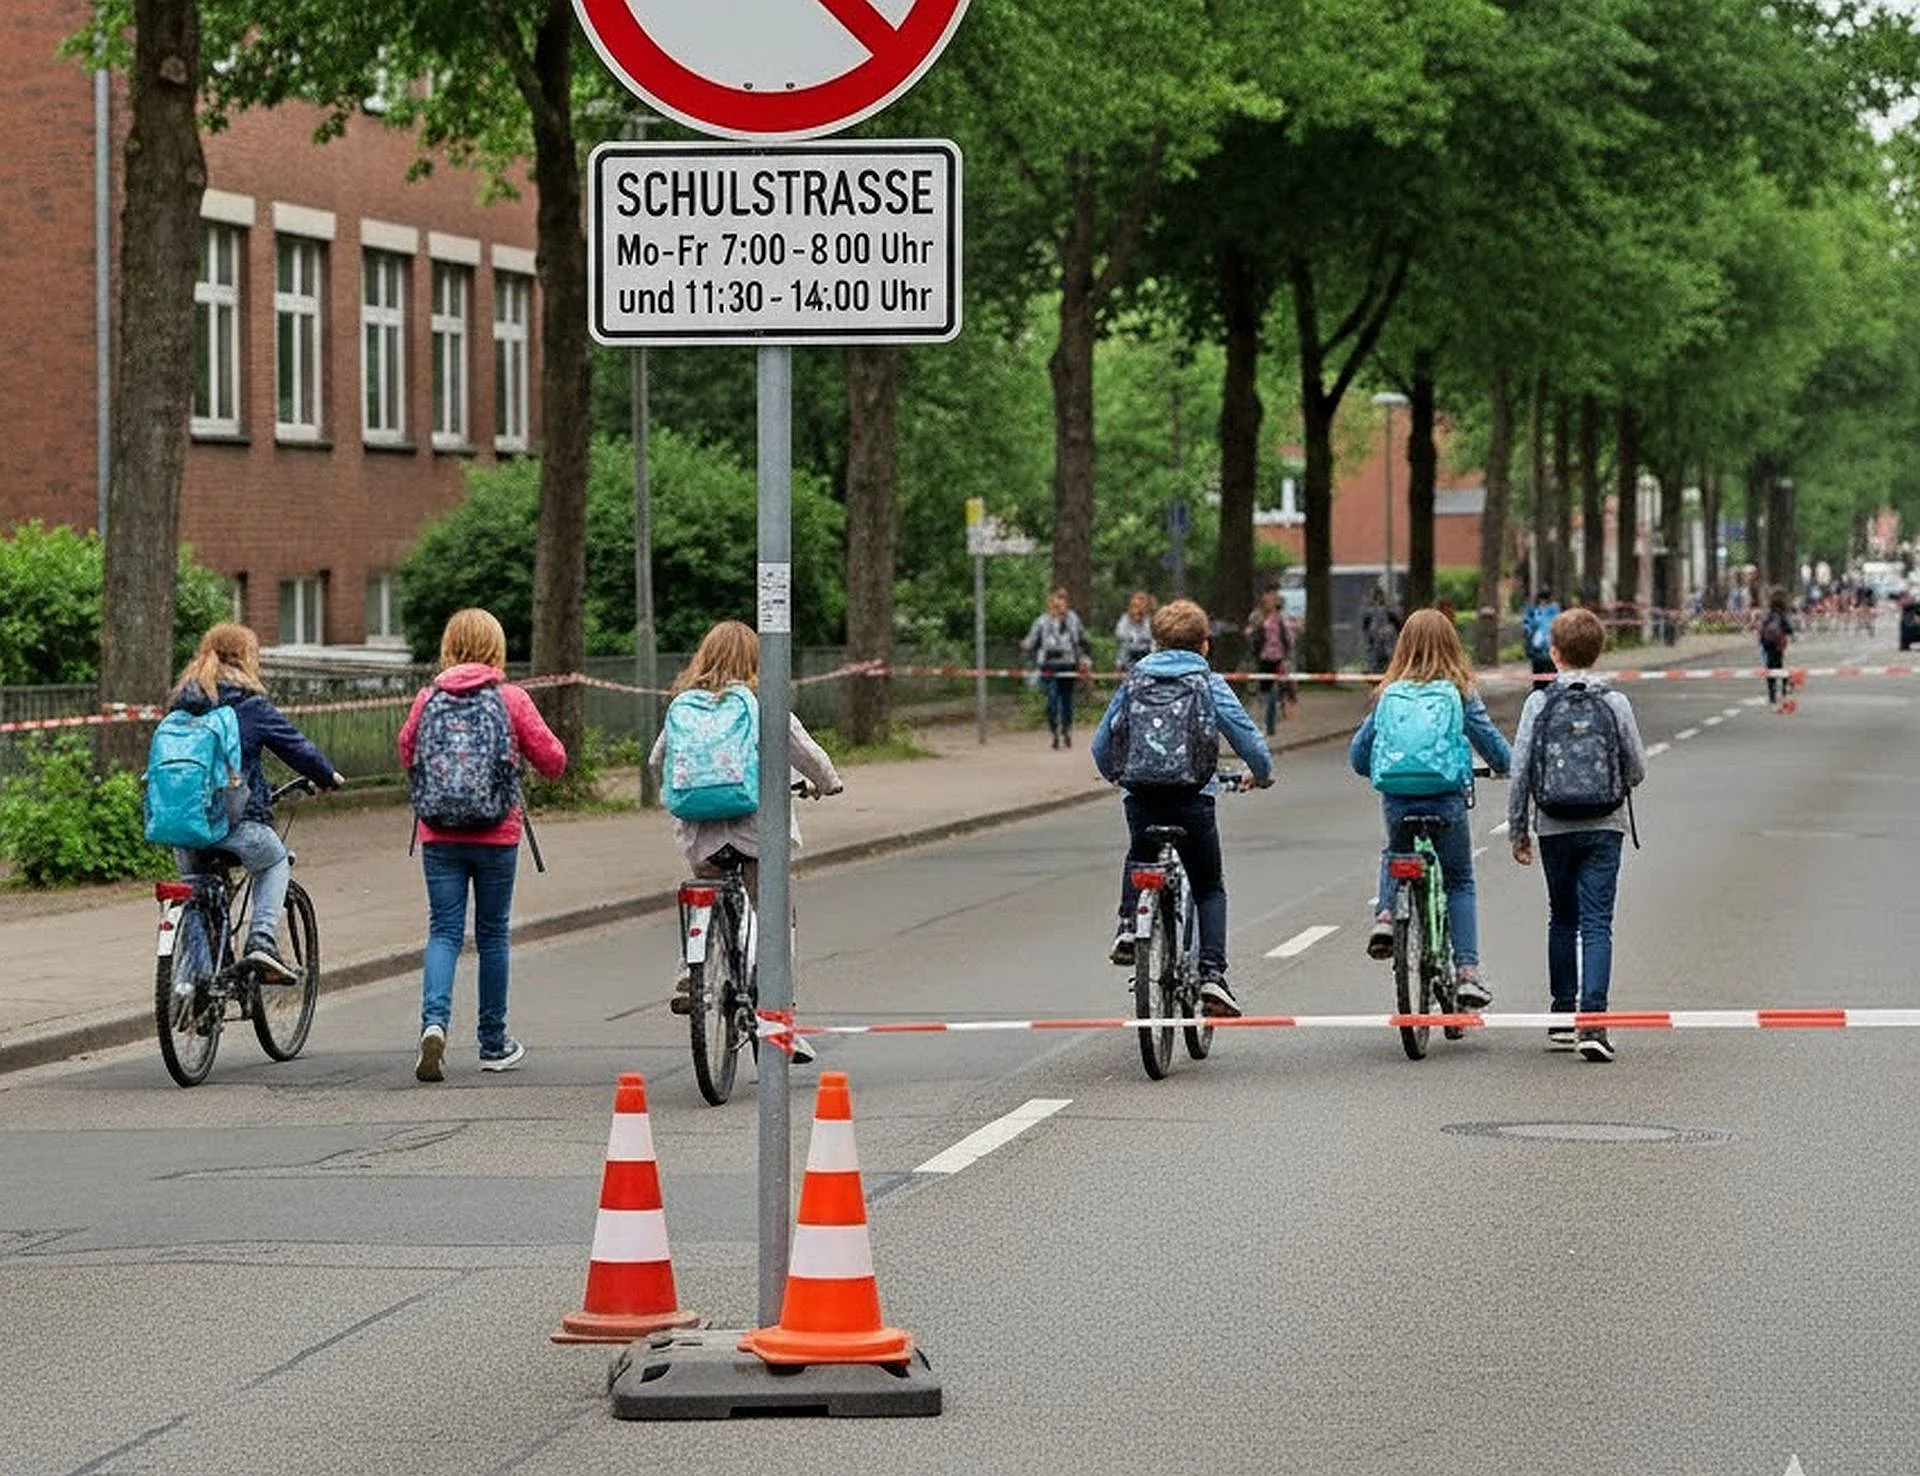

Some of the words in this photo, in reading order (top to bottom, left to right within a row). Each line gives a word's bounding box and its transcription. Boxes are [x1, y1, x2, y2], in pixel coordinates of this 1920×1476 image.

[617, 168, 934, 217] SCHULSTRASSE
[617, 233, 709, 267] Mo-Fr
[881, 231, 934, 264] Uhr
[619, 279, 675, 314] und
[880, 278, 933, 312] Uhr
